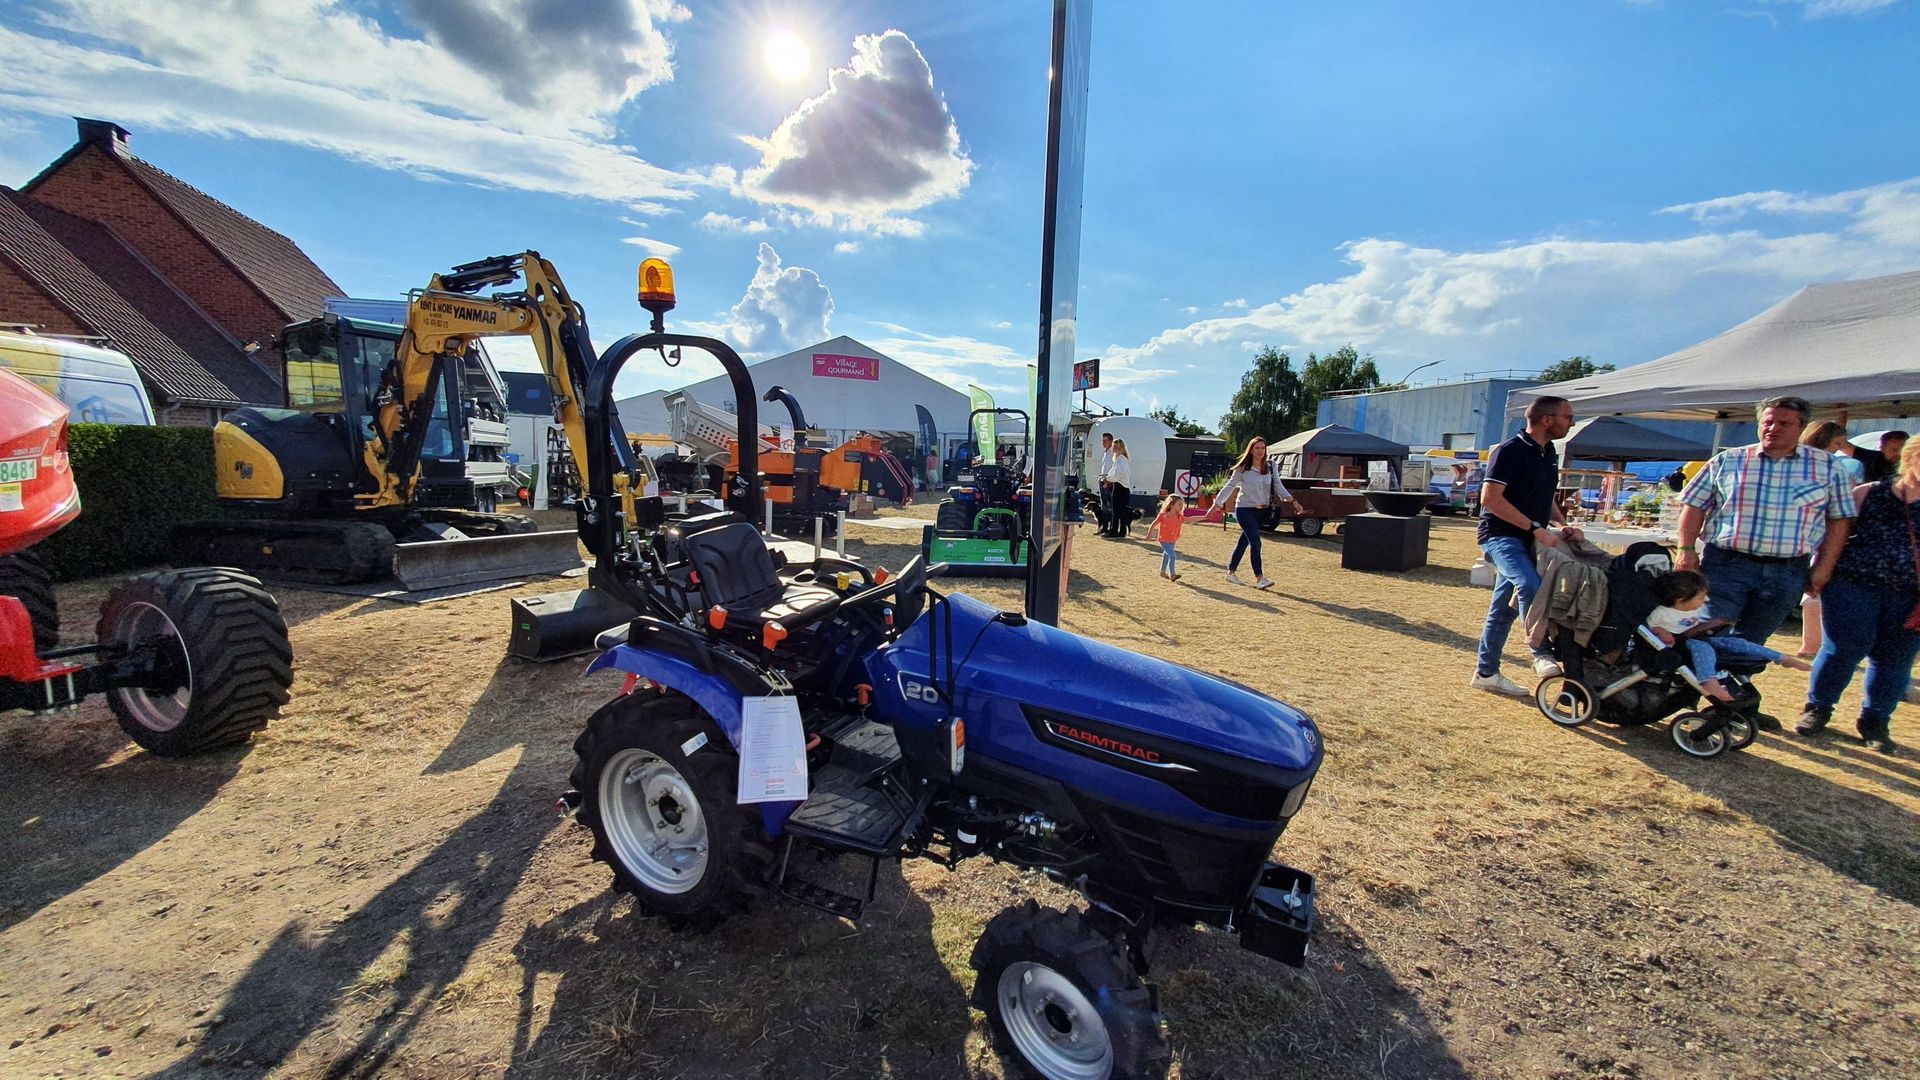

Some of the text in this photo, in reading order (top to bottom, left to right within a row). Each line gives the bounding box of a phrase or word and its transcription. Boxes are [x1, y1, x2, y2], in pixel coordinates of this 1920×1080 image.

[437, 302, 453, 314] MORE
[453, 306, 497, 325] YANMAR
[0, 460, 36, 482] 8481
[906, 681, 939, 704] 20
[1058, 724, 1160, 763] FARMTRAC
